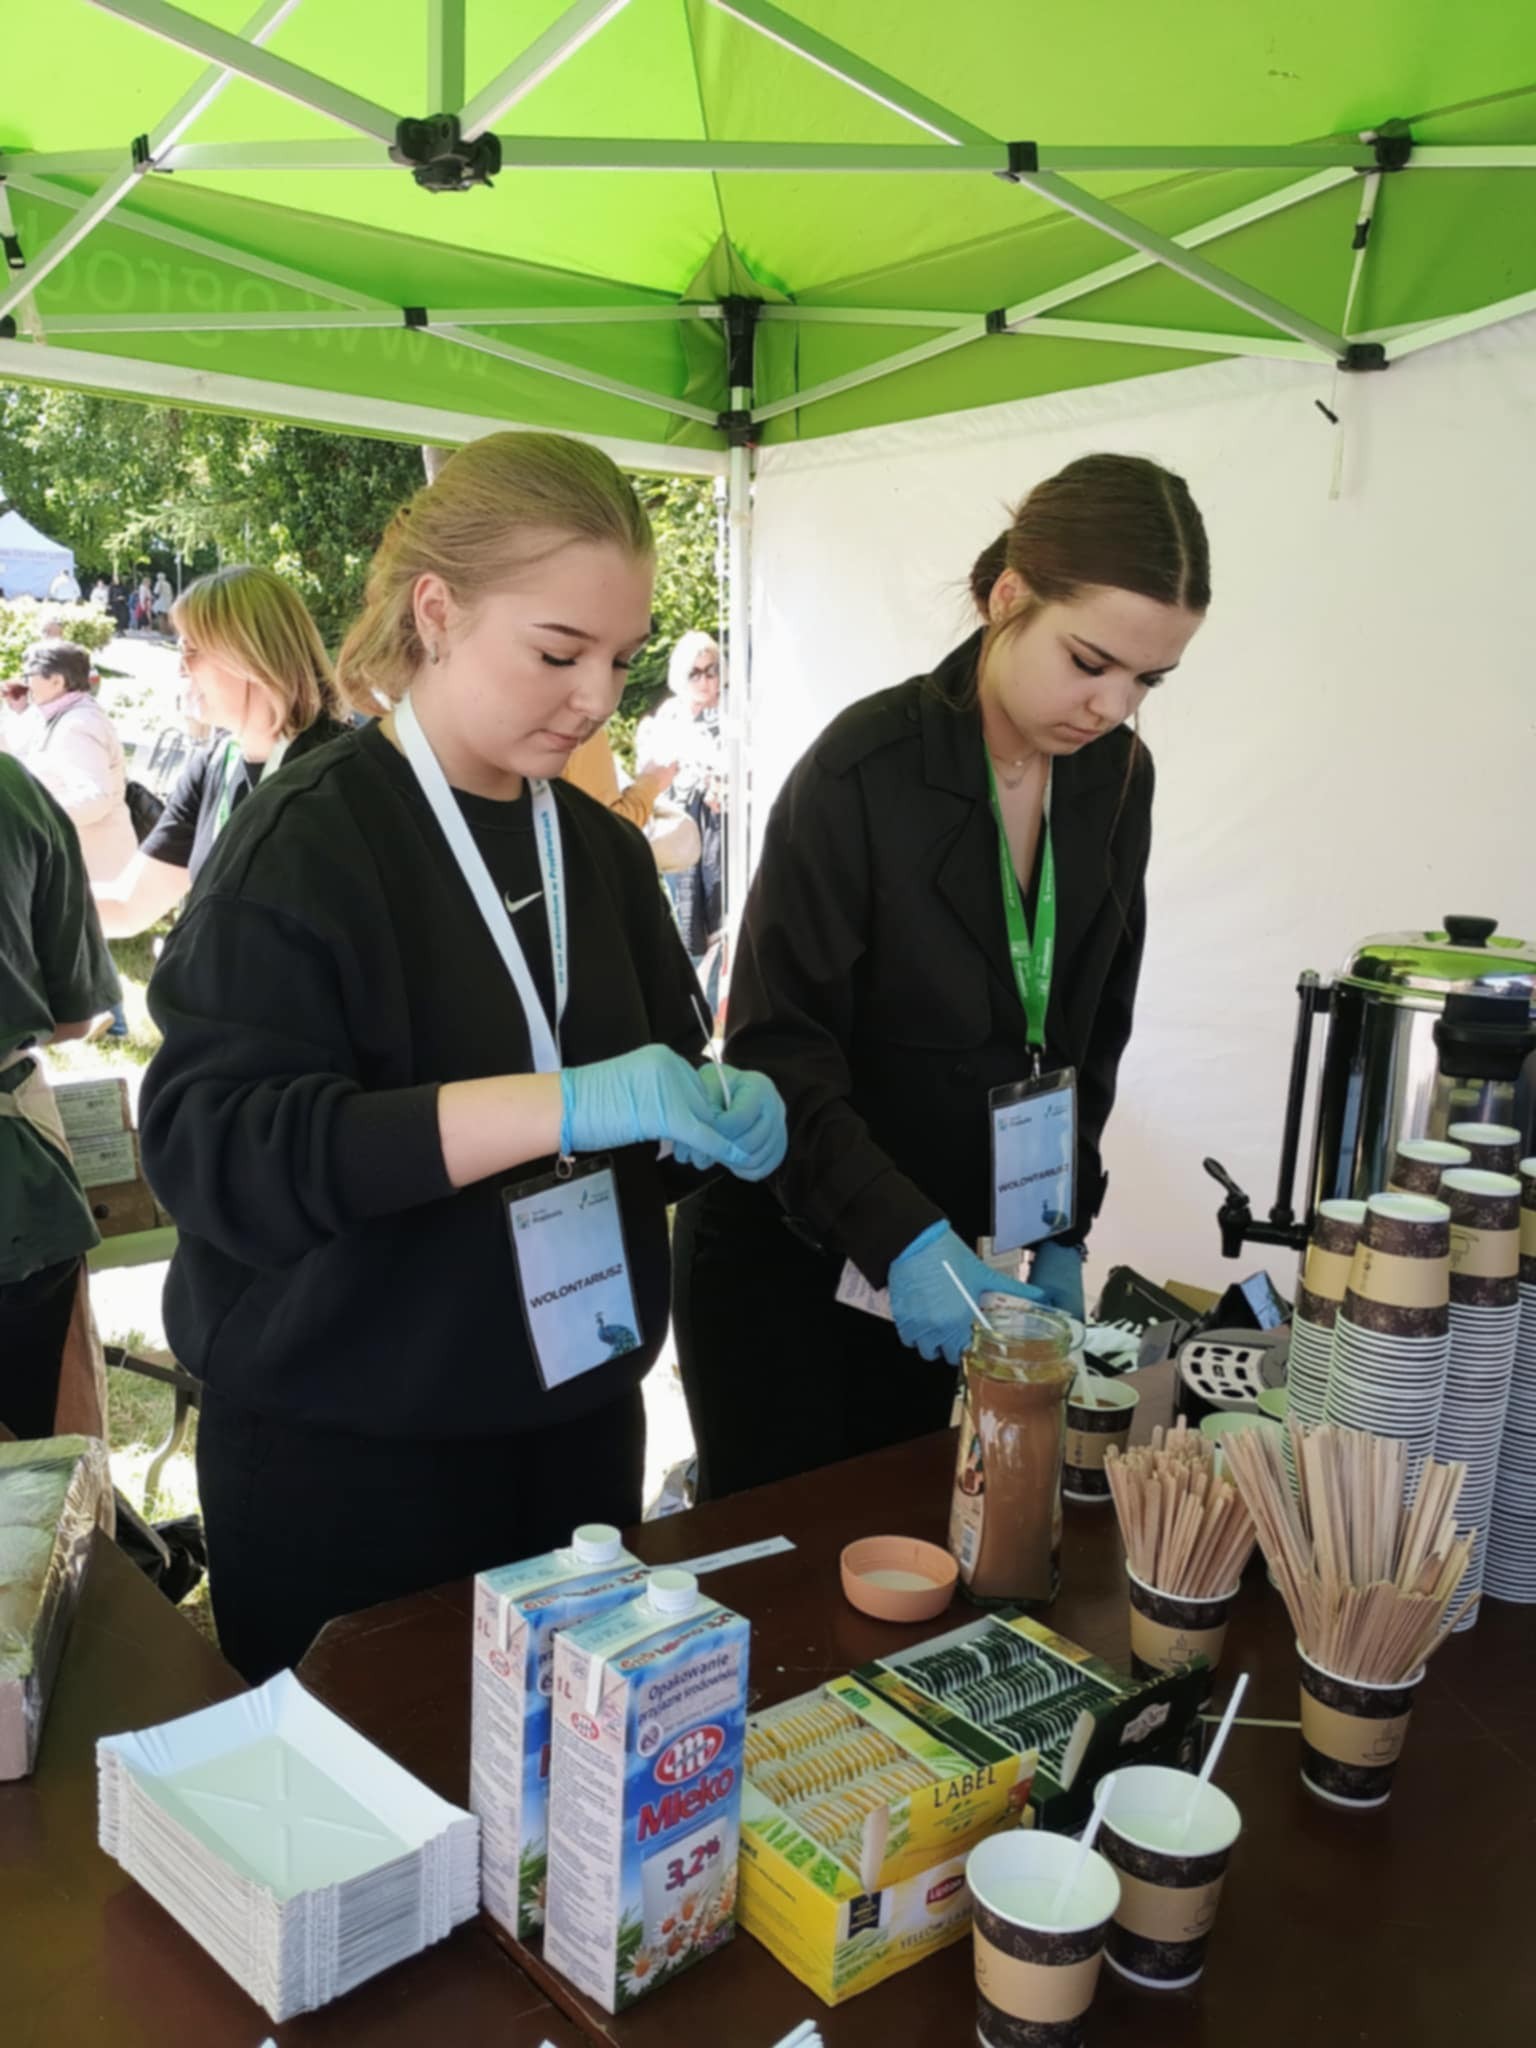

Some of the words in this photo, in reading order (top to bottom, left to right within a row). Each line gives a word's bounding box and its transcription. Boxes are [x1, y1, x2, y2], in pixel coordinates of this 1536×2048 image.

[529, 1263, 622, 1308] WOLONTARIUSZ
[648, 1654, 729, 1700] Opakowanie
[637, 1767, 735, 1842] Mleko
[934, 1765, 997, 1808] LABEL
[664, 1835, 720, 1891] 3,2%
